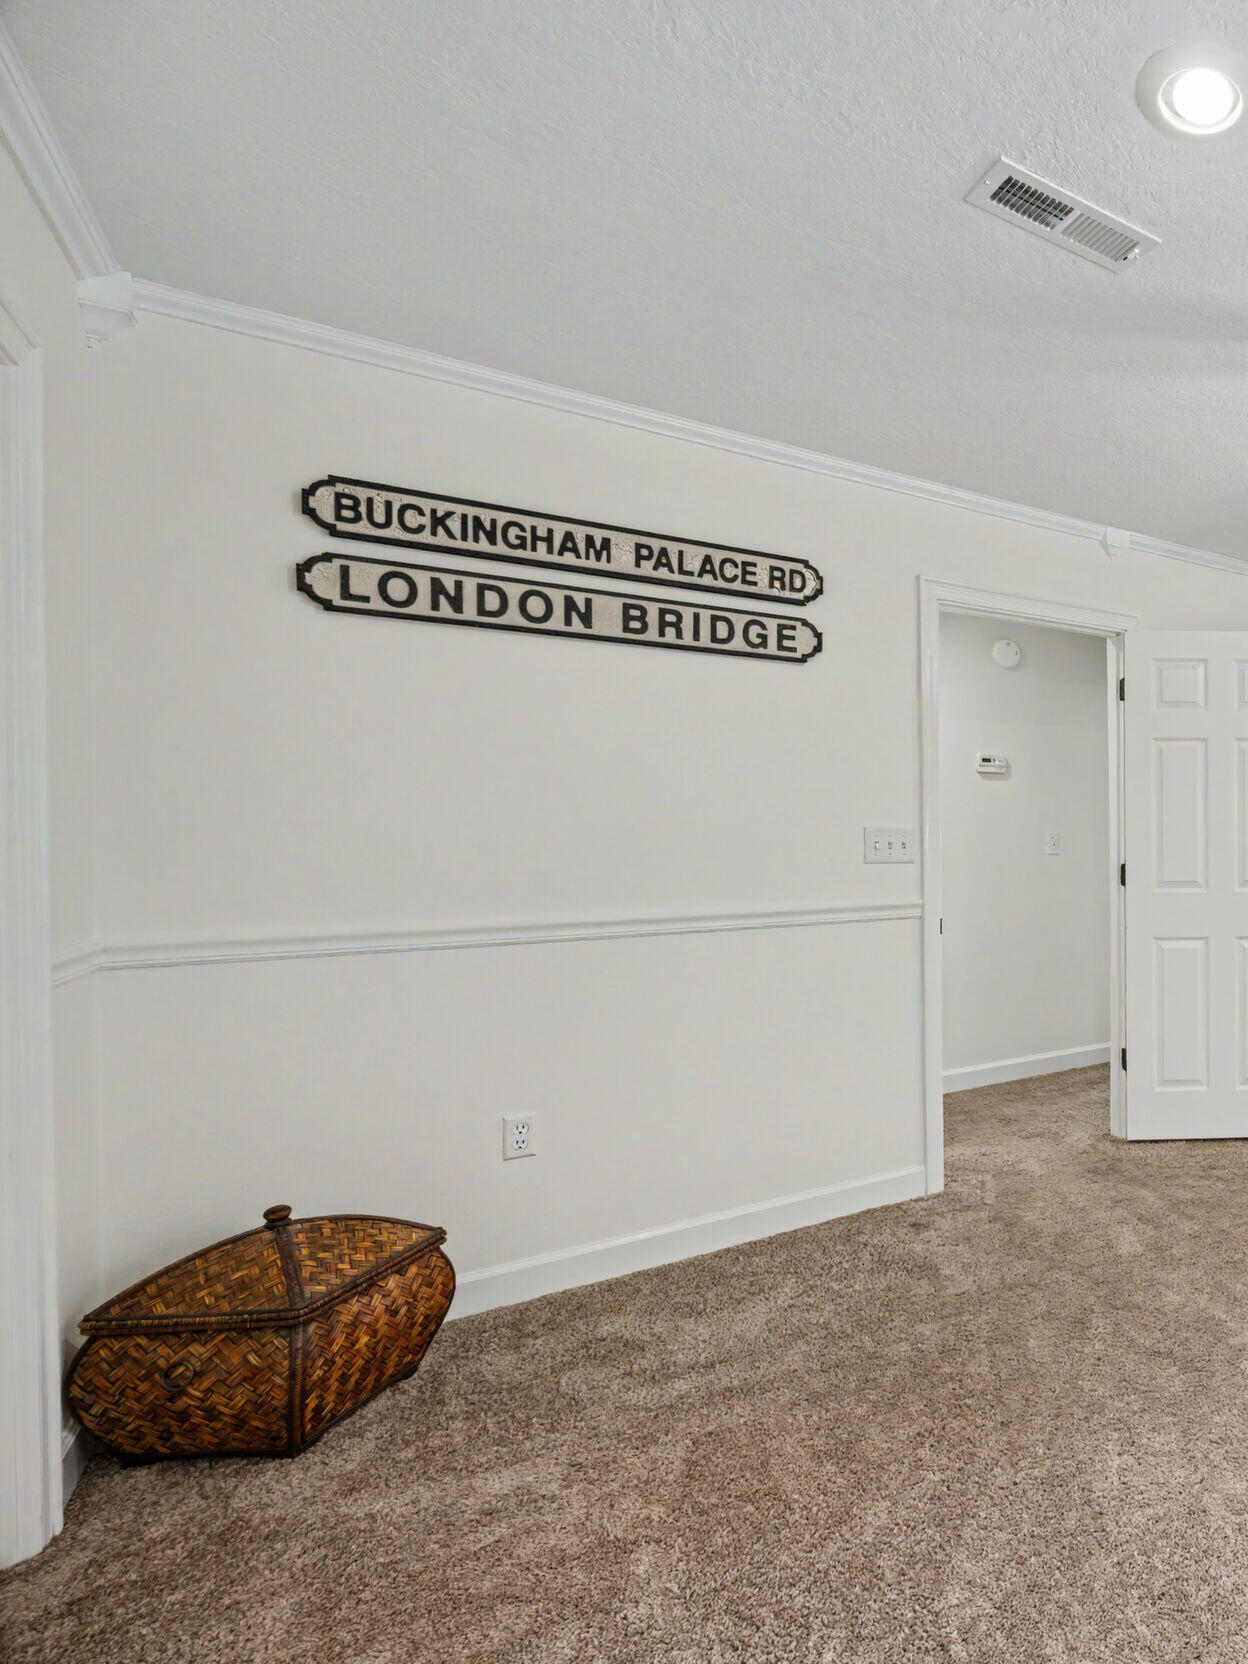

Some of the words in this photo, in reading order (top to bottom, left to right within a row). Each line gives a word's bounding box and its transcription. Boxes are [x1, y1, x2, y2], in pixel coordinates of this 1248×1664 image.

[333, 491, 612, 564] BUCKINGHAM
[634, 542, 759, 587] PALACE
[768, 564, 807, 594] RD
[339, 564, 594, 630] LONDON
[622, 601, 799, 654] BRIDGE
